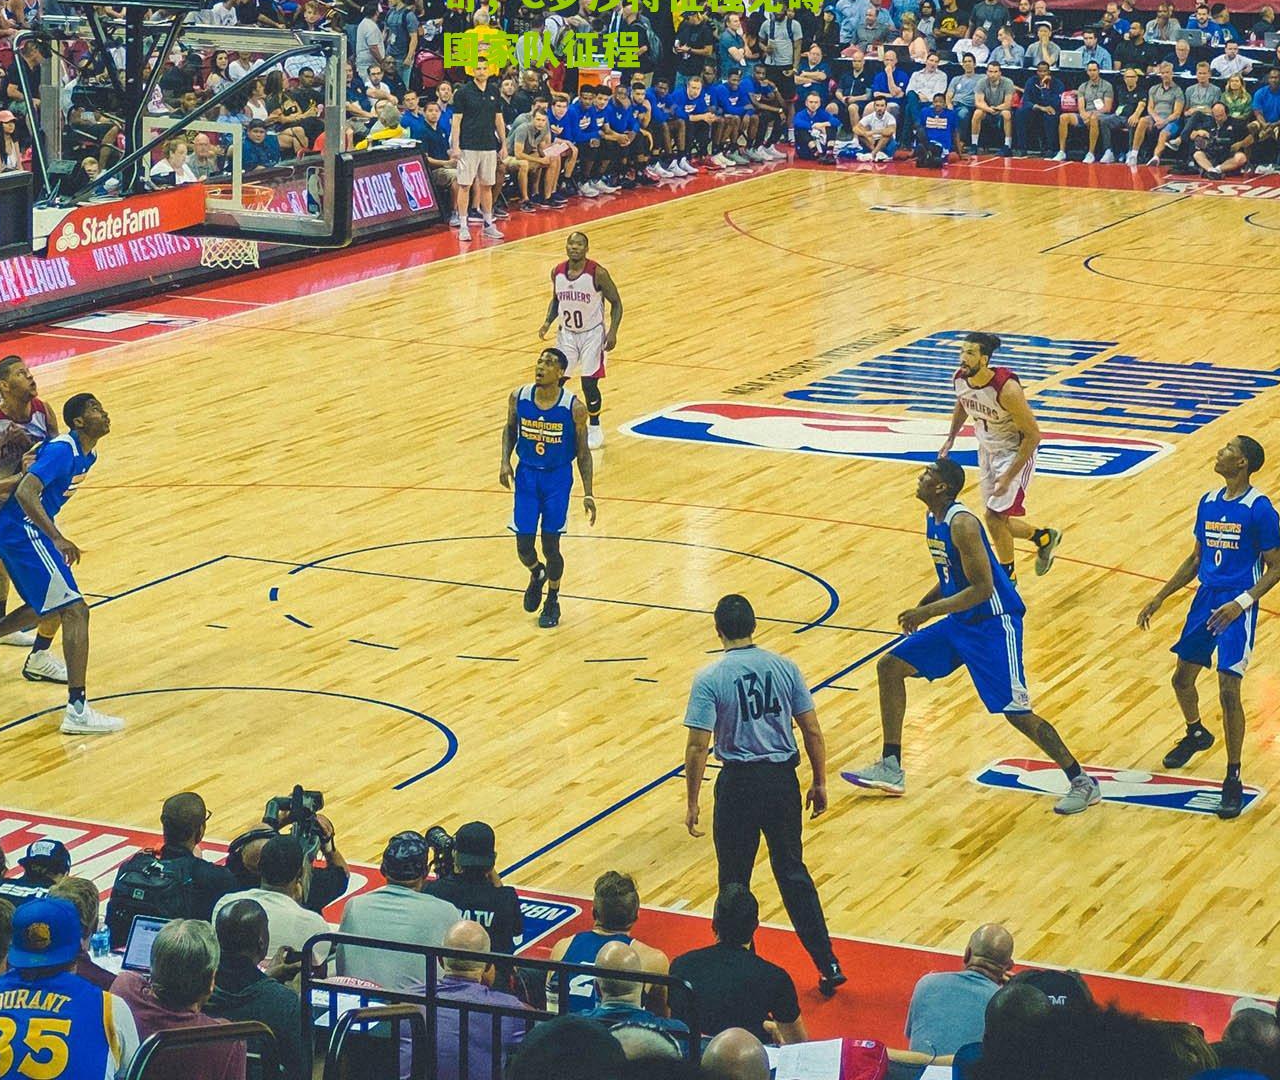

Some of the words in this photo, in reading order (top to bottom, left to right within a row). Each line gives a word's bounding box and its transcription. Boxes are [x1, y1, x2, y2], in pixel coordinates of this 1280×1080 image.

[359, 171, 402, 218] LEAGUE
[410, 170, 428, 198] TV
[92, 242, 129, 270] MGM
[128, 232, 191, 262] RESORTS
[19, 256, 76, 295] LEAGUE
[563, 310, 584, 329] 20
[535, 442, 545, 456] 6
[734, 670, 782, 722] 134
